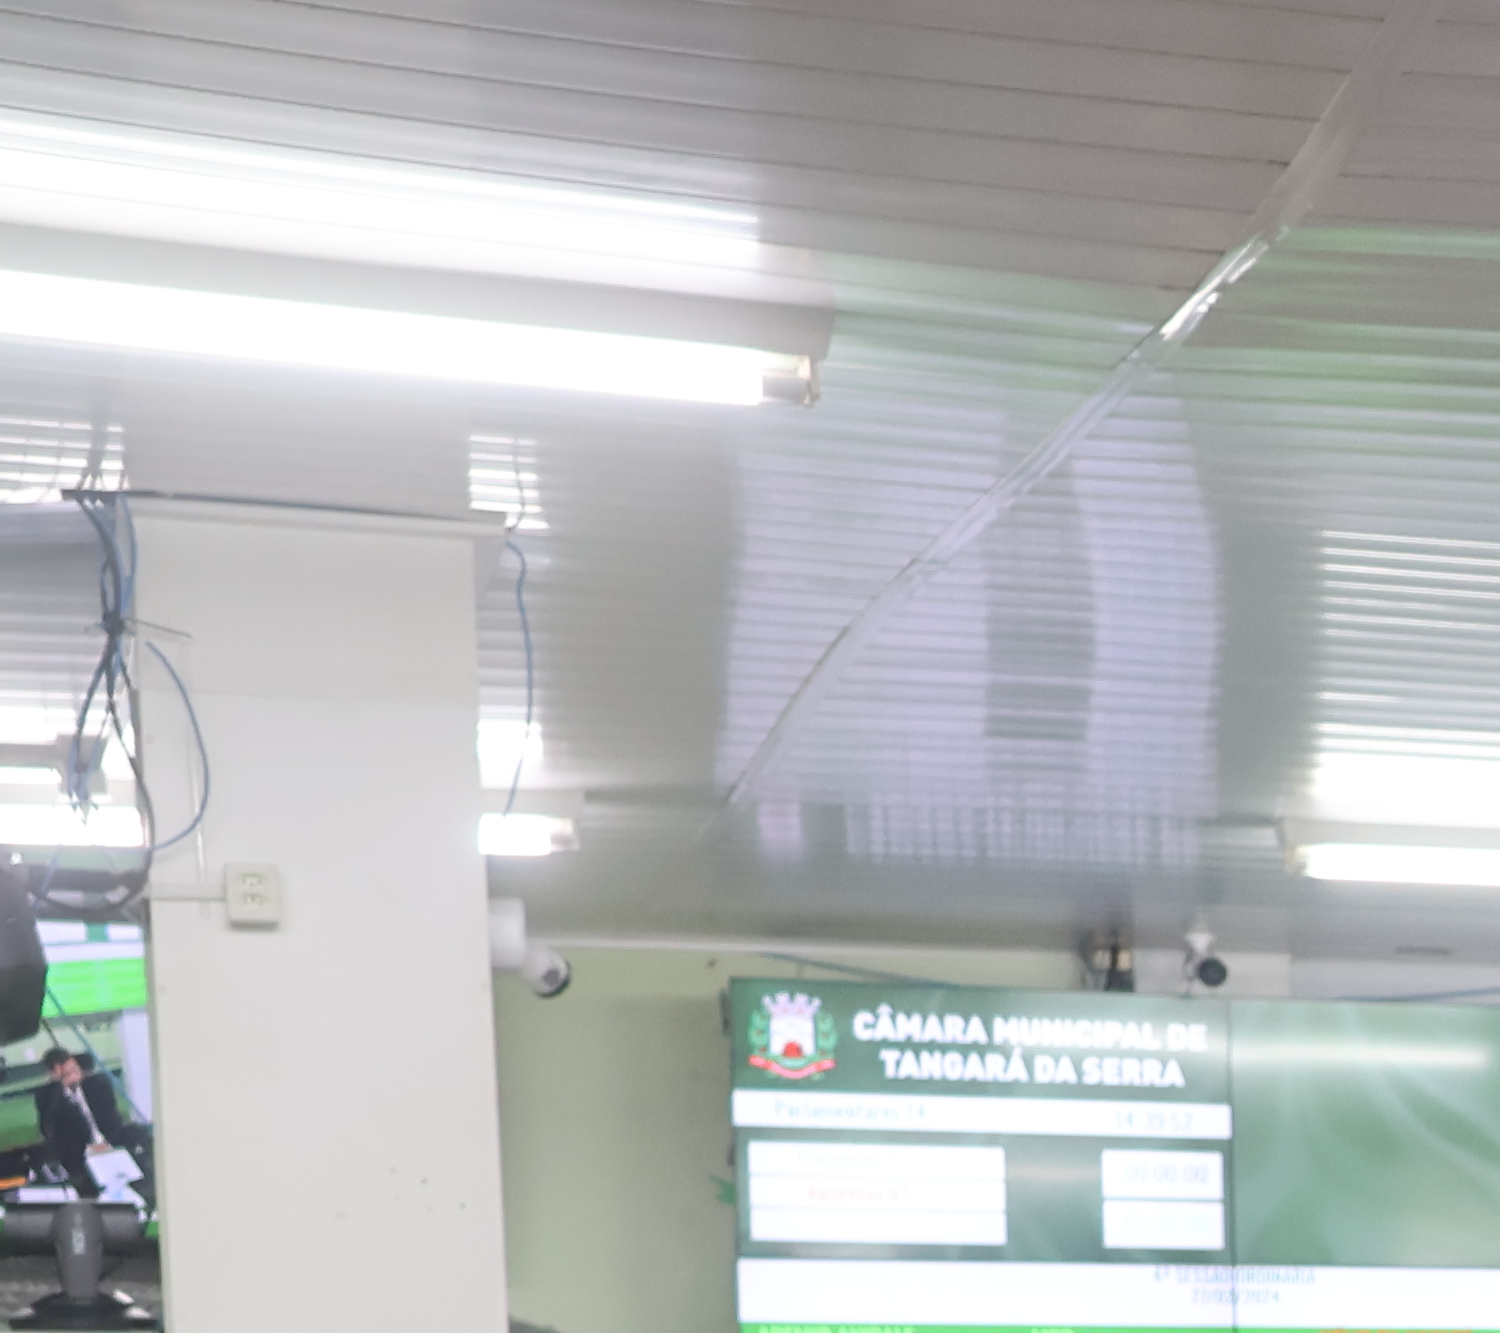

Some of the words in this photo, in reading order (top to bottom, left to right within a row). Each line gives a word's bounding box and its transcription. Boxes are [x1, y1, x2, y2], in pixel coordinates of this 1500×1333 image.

[852, 1004, 989, 1046] CÂMARA
[993, 1016, 1162, 1051] MUNICIPAL
[1167, 1023, 1208, 1053] DE
[879, 1047, 1029, 1083] TANGARÁ
[1034, 1056, 1078, 1085] DA
[1081, 1057, 1187, 1088] SERRA
